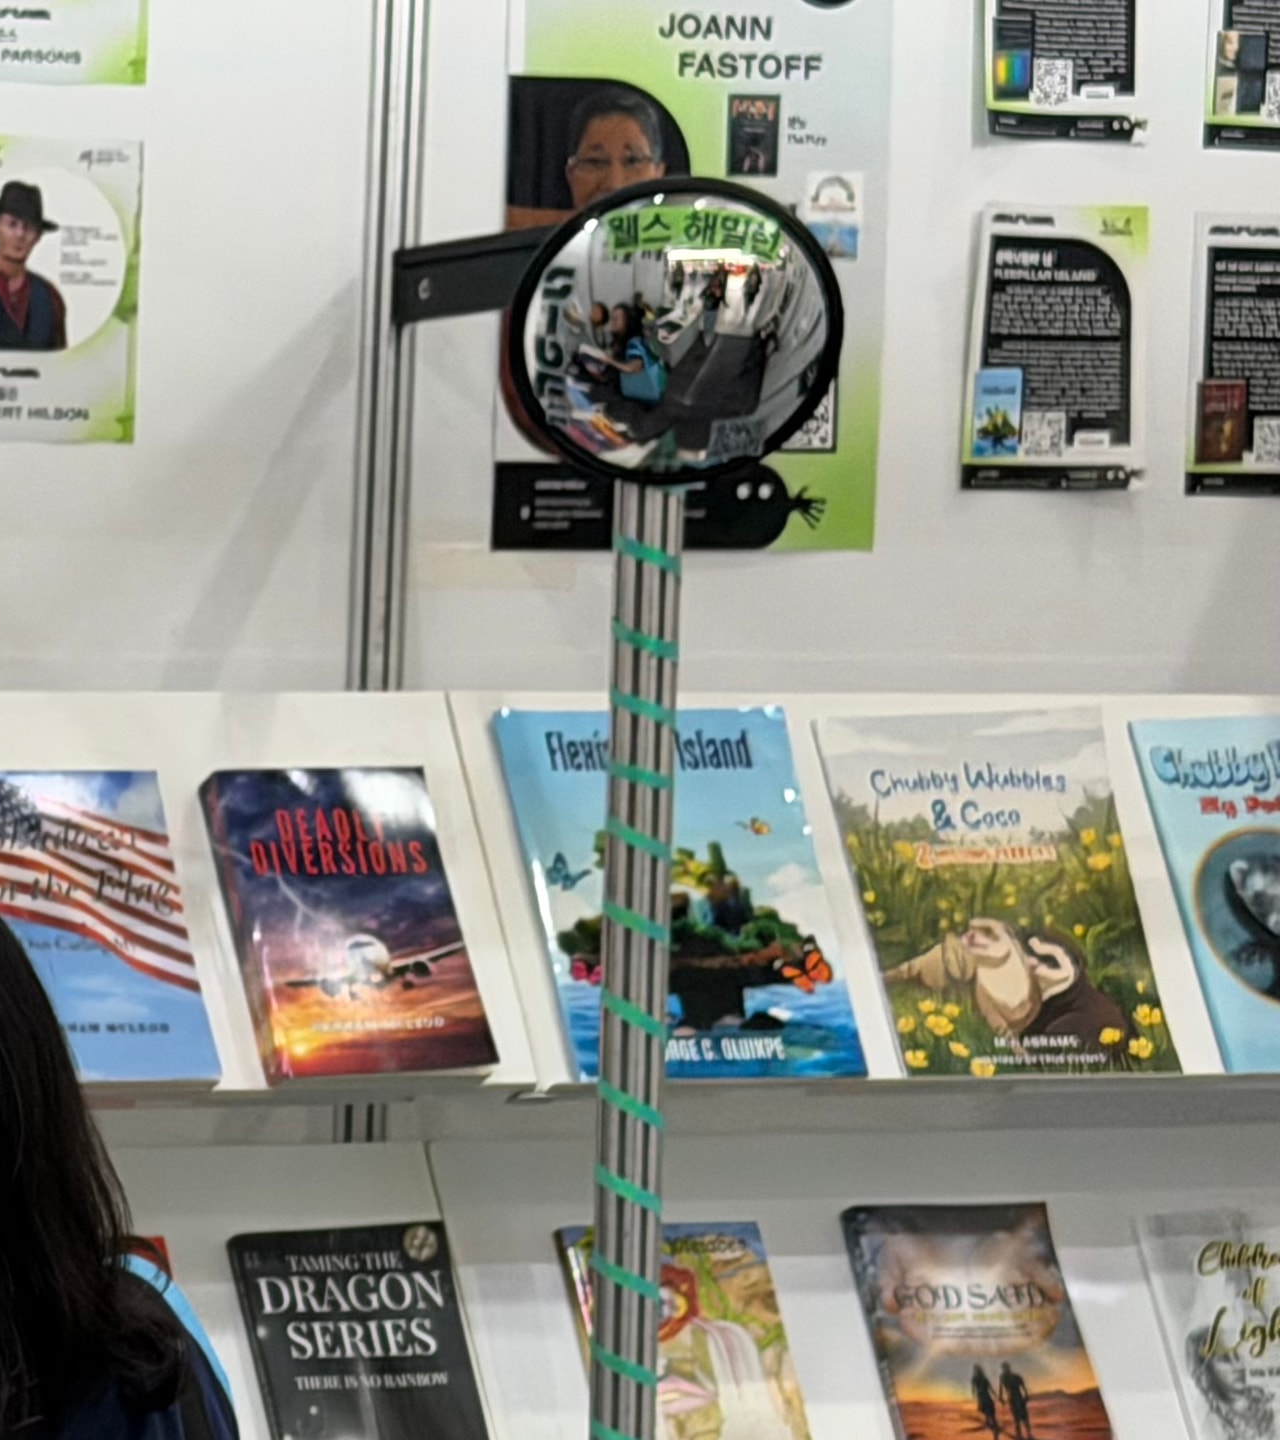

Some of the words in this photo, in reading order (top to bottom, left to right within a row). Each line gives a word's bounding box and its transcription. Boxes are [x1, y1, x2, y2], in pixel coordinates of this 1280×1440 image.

[658, 12, 774, 42] JOANN
[0, 48, 82, 65] PARSONS
[677, 51, 824, 81] FASTOFF
[672, 729, 753, 771] Island
[870, 769, 959, 798] Chubby
[963, 761, 1067, 793] Wubbles
[1149, 745, 1272, 795] Chubby
[931, 798, 956, 831] &
[960, 799, 1022, 831] Coco
[250, 840, 428, 877] DIVERSIONS
[286, 1252, 359, 1272] TAMING
[360, 1250, 404, 1270] THE
[1197, 1240, 1280, 1277] Childre
[257, 1269, 446, 1316] DRAGON
[286, 1317, 438, 1360] SERIES
[1199, 1306, 1280, 1359] Ligh
[295, 1375, 341, 1391] THERE
[383, 1371, 449, 1389] RAINBOW
